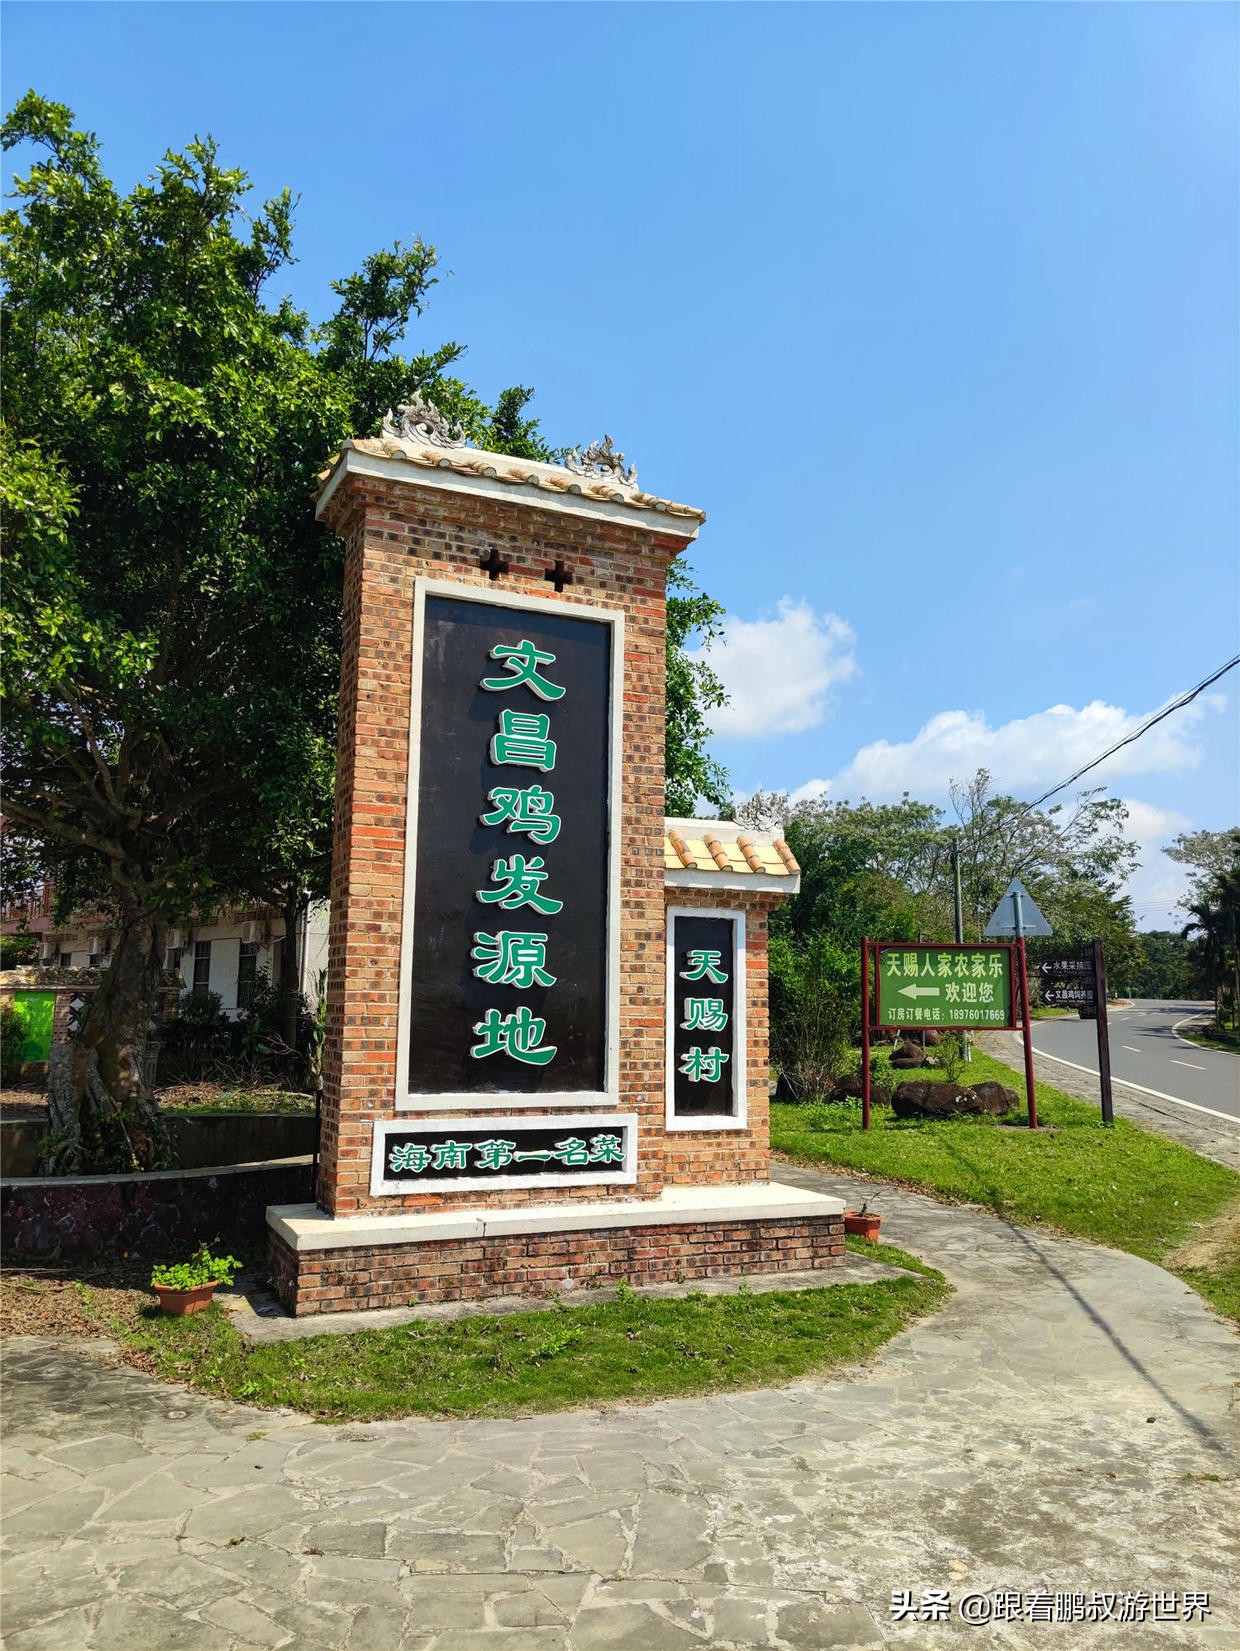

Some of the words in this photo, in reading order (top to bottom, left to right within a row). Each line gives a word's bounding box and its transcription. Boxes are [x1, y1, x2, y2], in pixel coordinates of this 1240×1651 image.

[471, 639, 566, 1066] 文昌鸡发源地
[887, 952, 1003, 978] 天赐人家农家乐
[945, 982, 995, 1003] 欢迎您
[679, 950, 729, 1083] 天赐村
[949, 1009, 1005, 1020] 18976017669
[389, 1134, 626, 1173] 海南第一名菜
